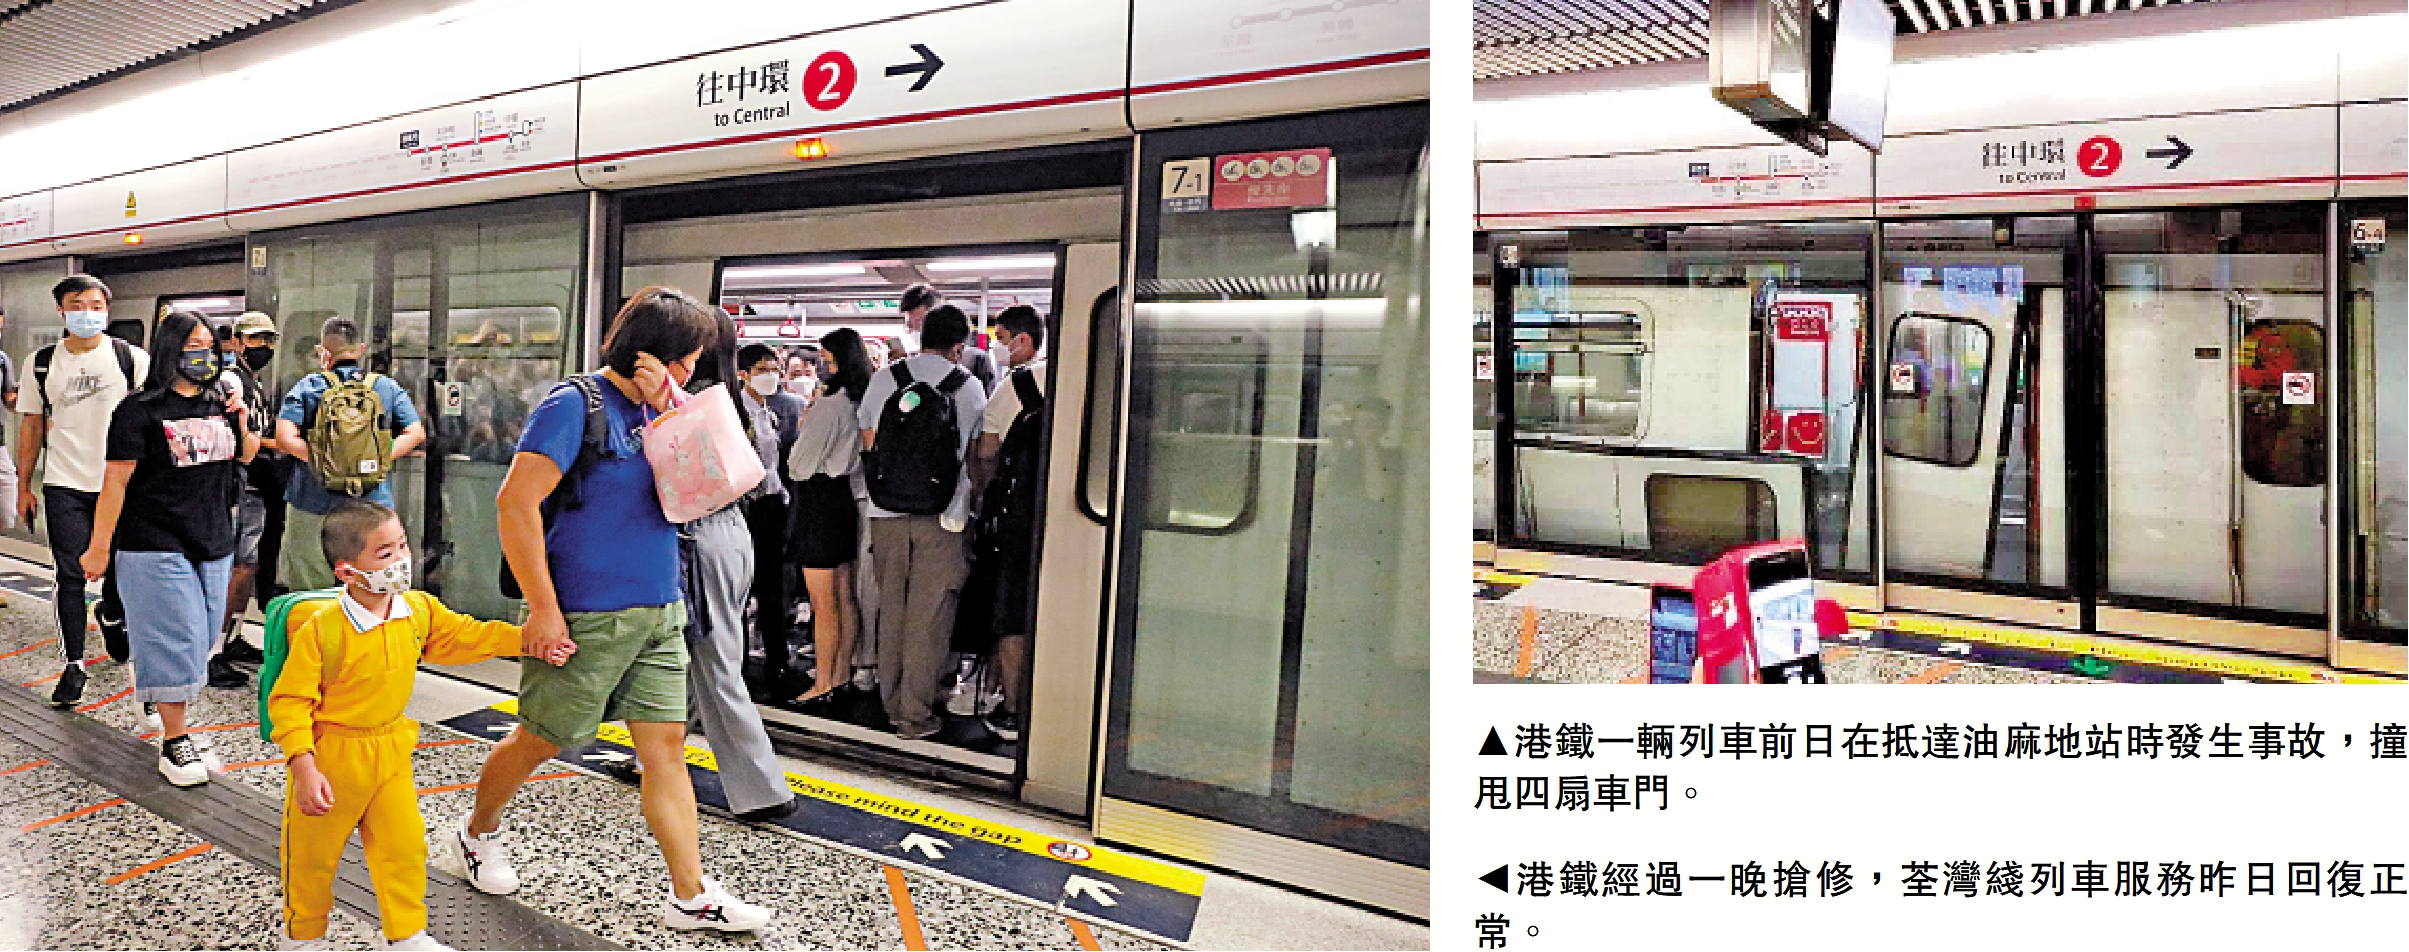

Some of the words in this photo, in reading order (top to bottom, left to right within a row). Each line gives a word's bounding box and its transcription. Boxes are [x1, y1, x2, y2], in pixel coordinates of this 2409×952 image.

[696, 59, 789, 107] 往中環
[817, 61, 841, 101] 2
[714, 112, 729, 126] to
[734, 101, 790, 124] Central
[2090, 142, 2109, 169] 2
[1171, 166, 1202, 193] 7-1
[854, 797, 920, 818] mind
[924, 814, 964, 830] the
[969, 826, 1022, 843] gap
